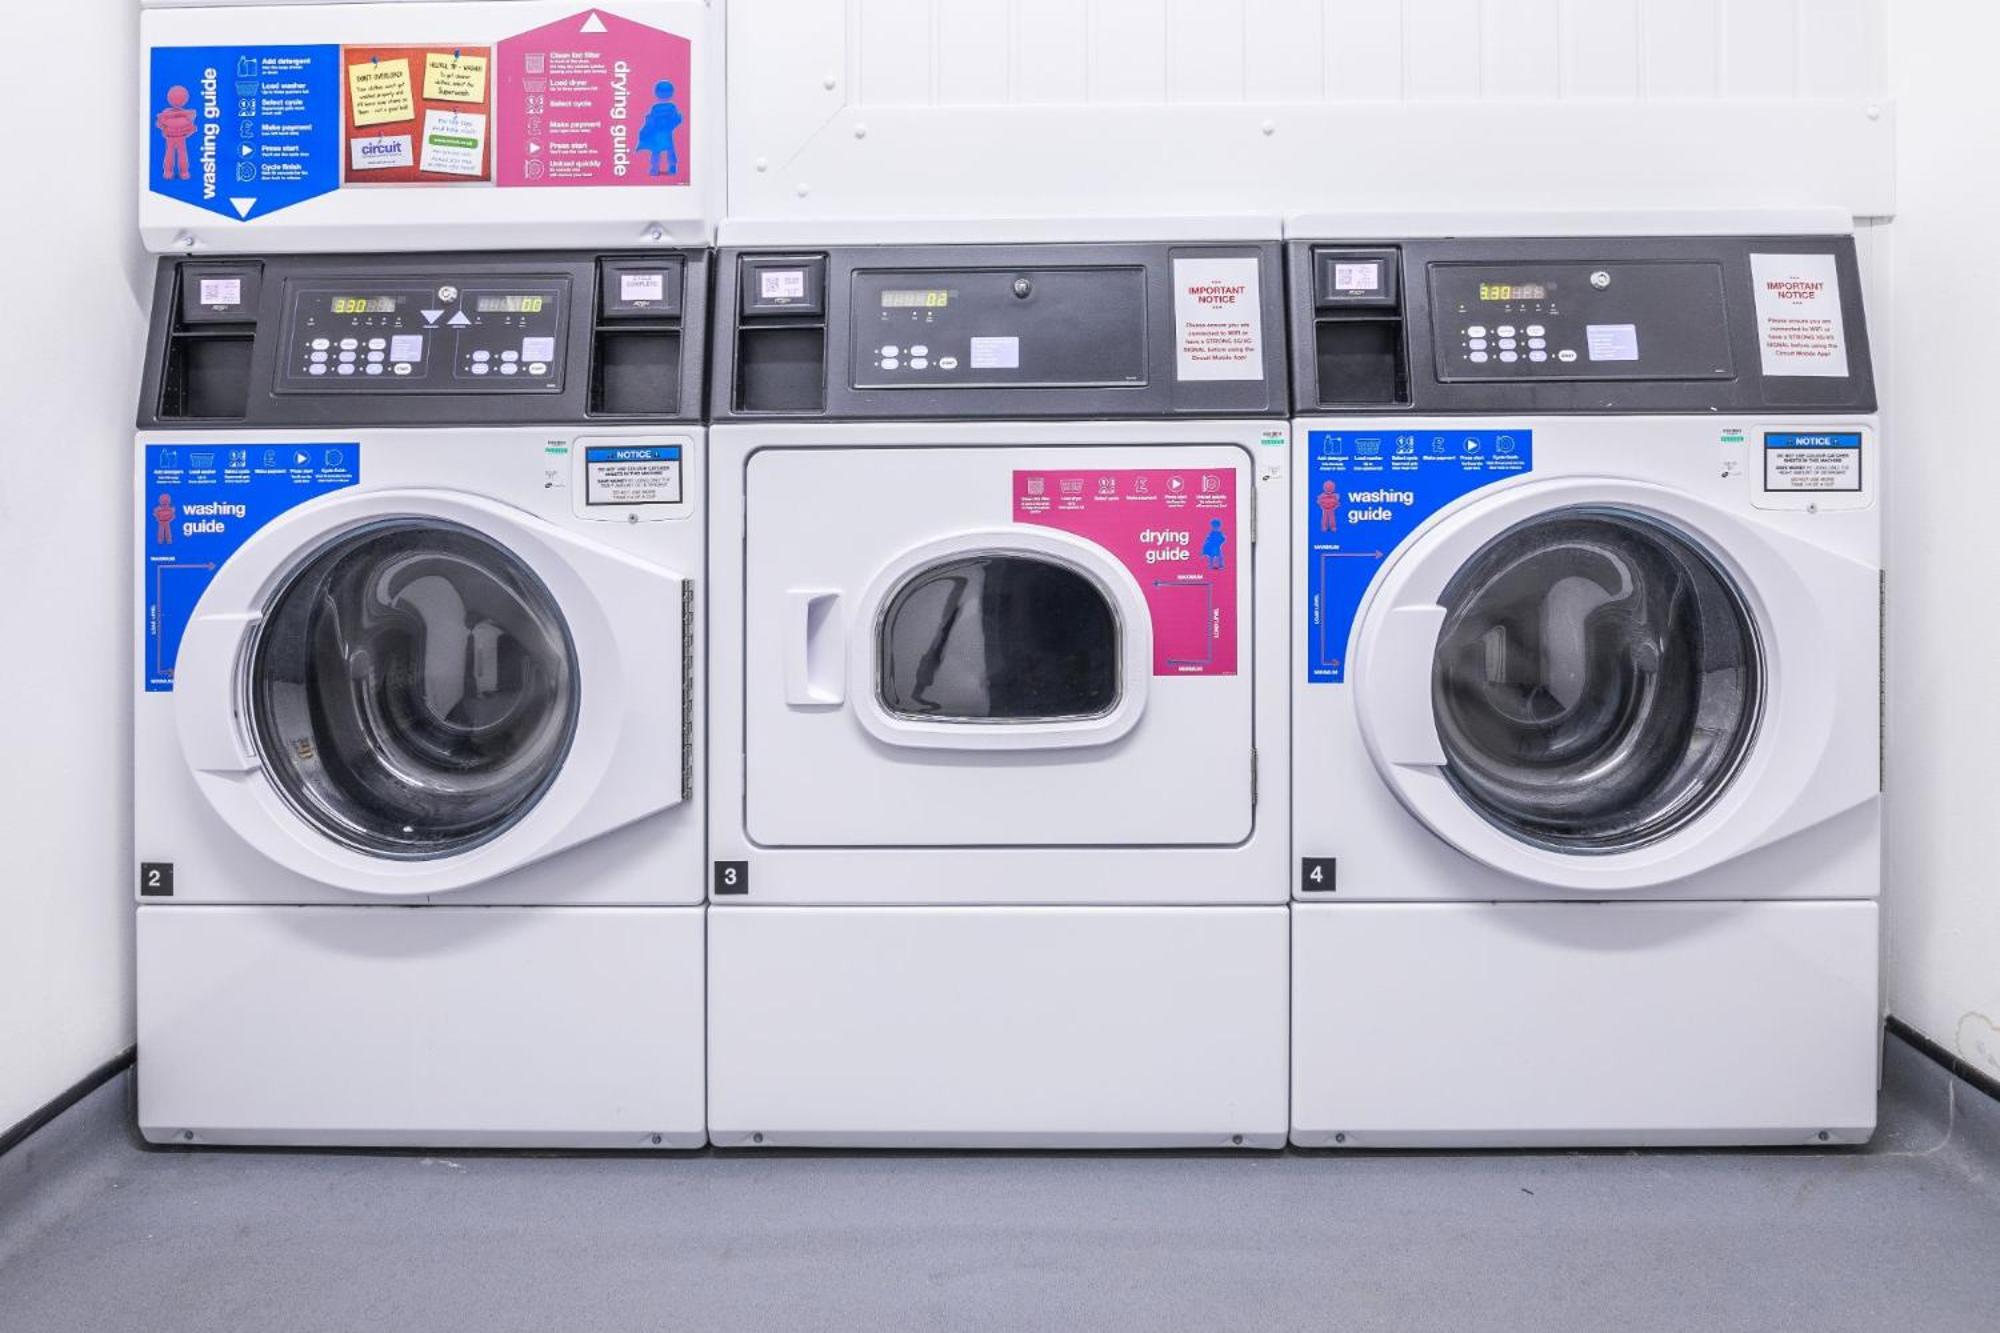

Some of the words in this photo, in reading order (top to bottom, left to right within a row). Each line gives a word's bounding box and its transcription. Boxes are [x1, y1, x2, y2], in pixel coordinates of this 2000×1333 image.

[201, 68, 220, 117] guide
[611, 61, 630, 119] drying
[362, 141, 402, 155] circuit
[611, 125, 630, 176] guide
[201, 124, 220, 199] washing
[1189, 286, 1245, 295] IMPORTANT
[1766, 282, 1824, 290] IMPORTANT
[1199, 295, 1236, 304] NOTICE
[1778, 291, 1815, 299] NOTICE
[1795, 437, 1831, 446] NOTICE
[616, 449, 652, 459] NOTICE
[1348, 489, 1414, 505] washing
[183, 502, 246, 518] washing
[1348, 507, 1392, 523] guide
[183, 520, 225, 536] guide
[1140, 529, 1189, 545] drying
[1145, 547, 1189, 564] guide
[148, 869, 161, 887] 2
[724, 867, 737, 885] 3
[1310, 865, 1324, 883] 4
